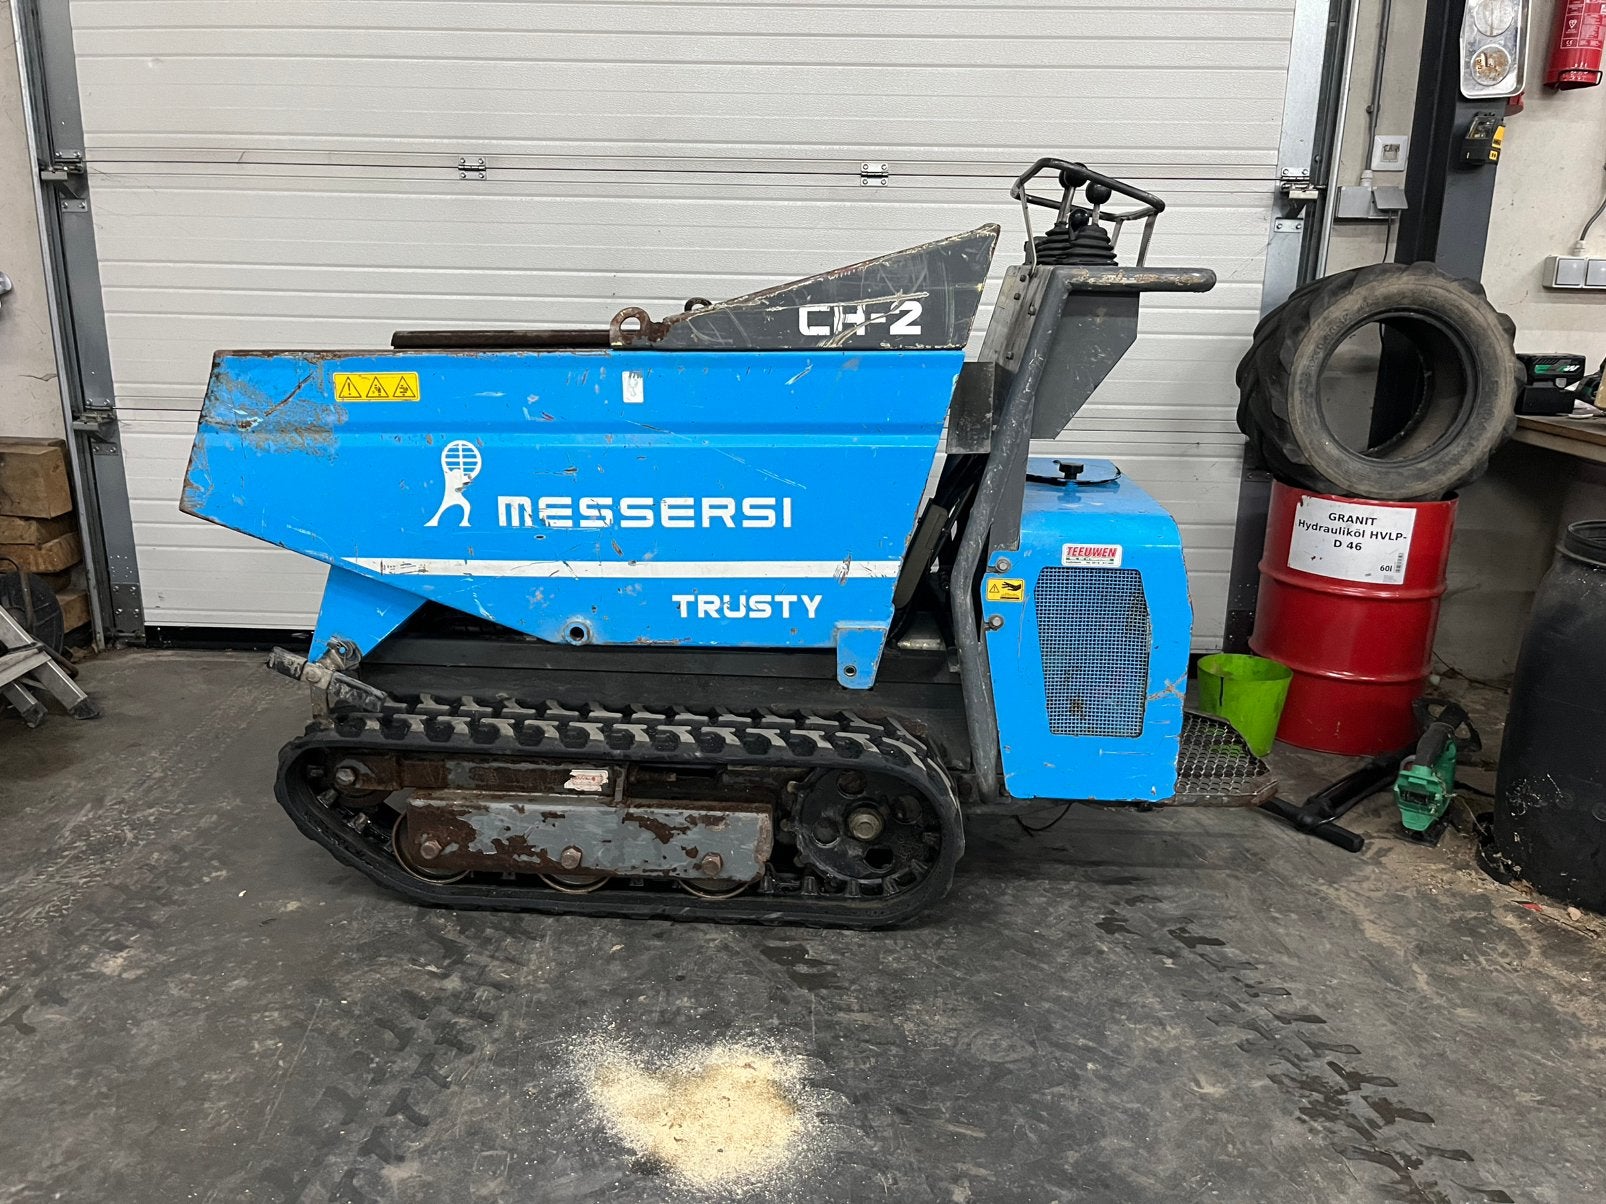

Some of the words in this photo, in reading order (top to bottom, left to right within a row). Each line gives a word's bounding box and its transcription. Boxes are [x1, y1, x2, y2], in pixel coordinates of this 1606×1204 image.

[799, 300, 923, 336] CH-2
[497, 495, 792, 528] MESSERSI
[1328, 513, 1377, 525] GRANIT
[1298, 519, 1366, 538] Hydrauliköl
[1370, 531, 1407, 541] HVLP-
[1067, 546, 1117, 557] TEEUWEN
[1334, 540, 1342, 548] D
[1346, 542, 1362, 551] 46
[671, 594, 823, 619] TRUSTY
